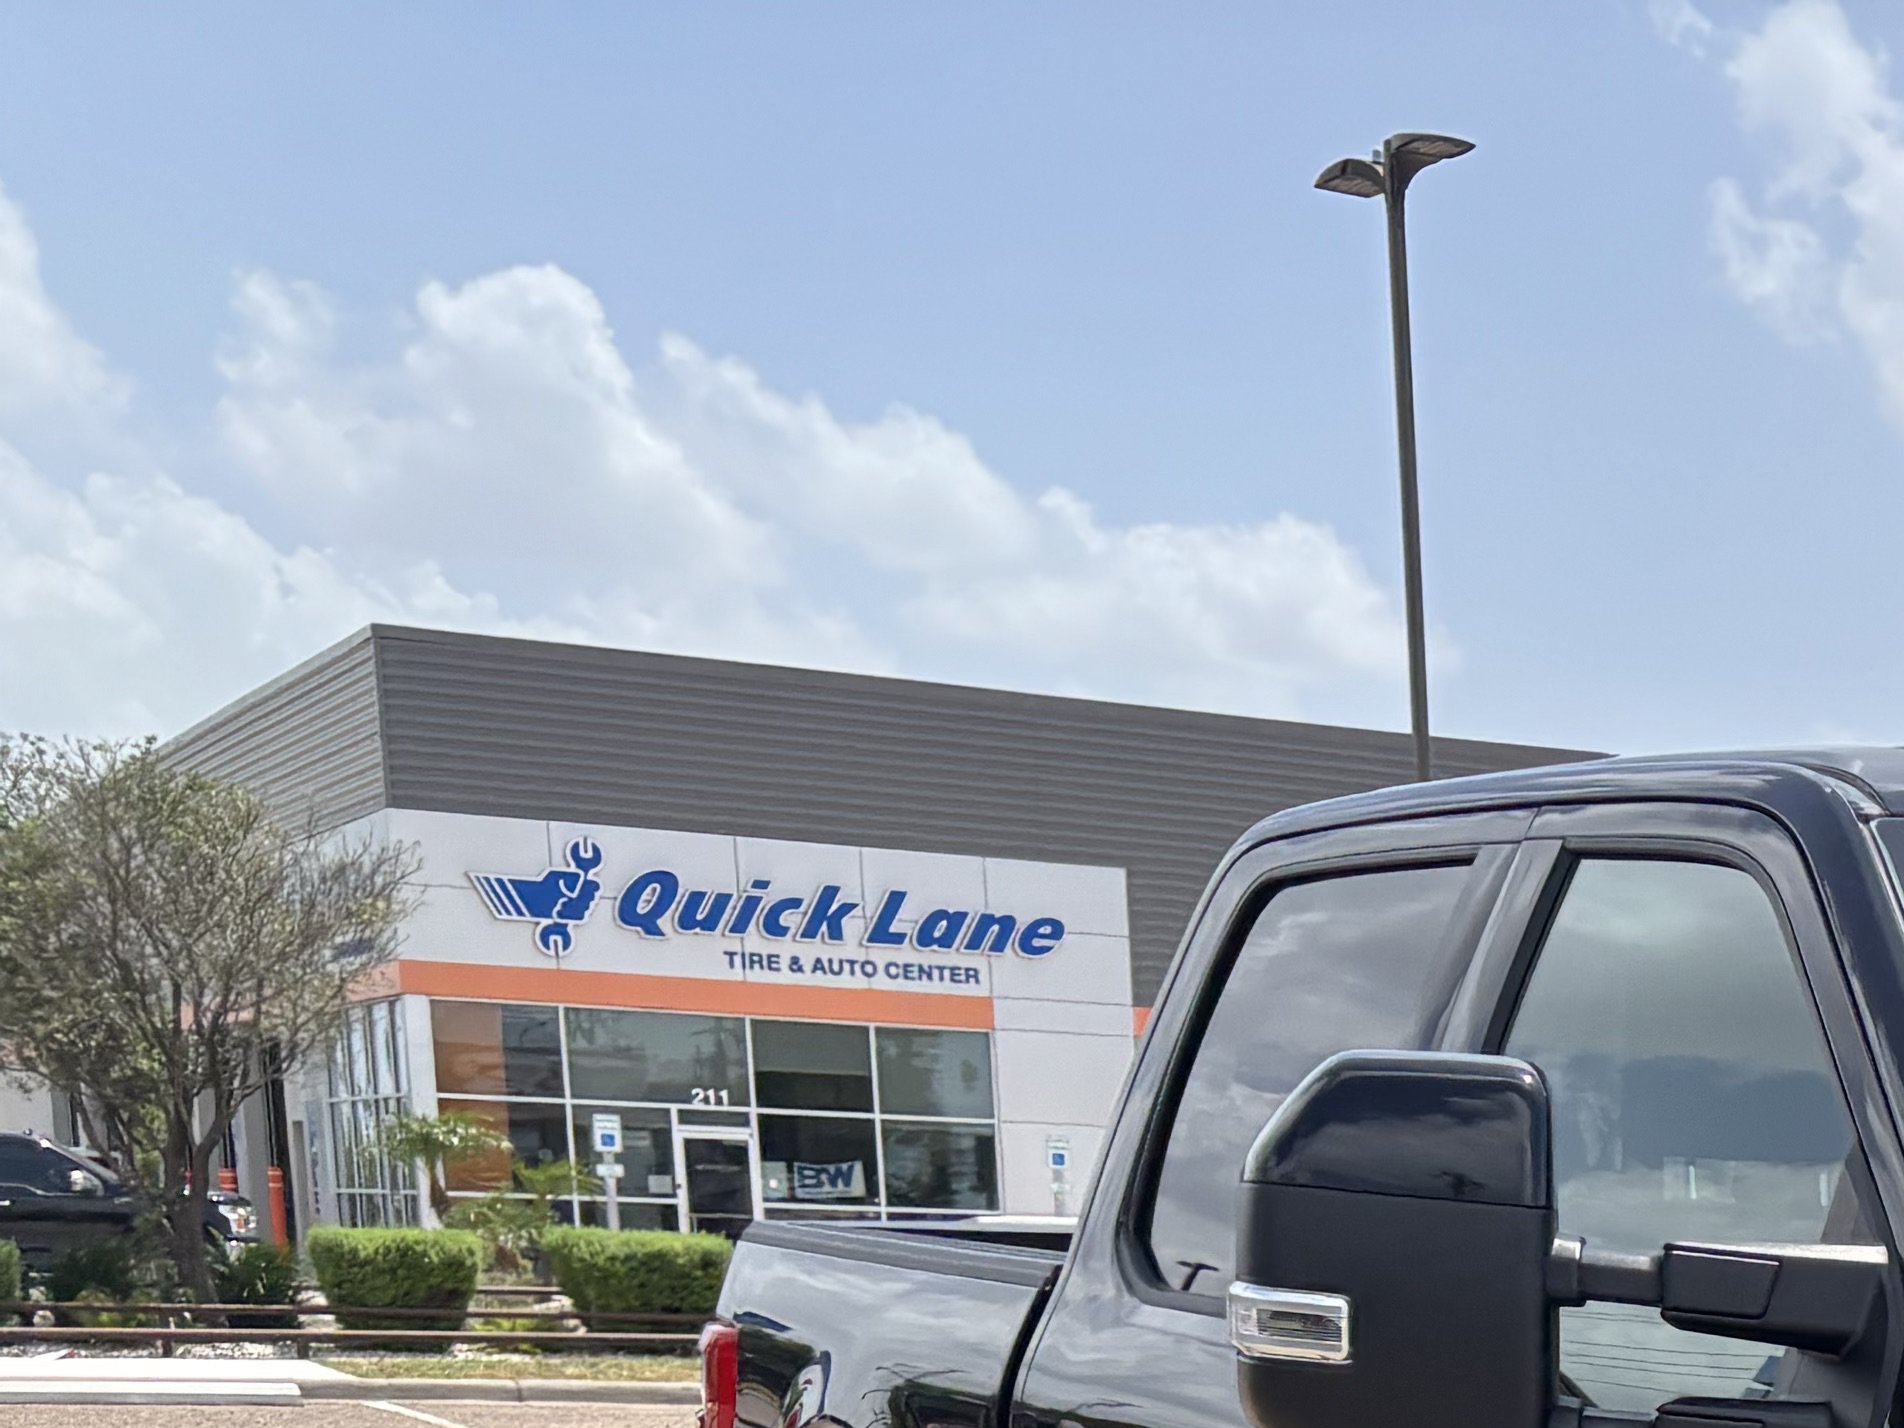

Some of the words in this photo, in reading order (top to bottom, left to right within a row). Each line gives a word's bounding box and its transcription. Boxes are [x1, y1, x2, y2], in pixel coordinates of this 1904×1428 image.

[616, 869, 861, 940] Quick
[865, 890, 1066, 955] Lane
[723, 951, 781, 972] TIRE
[788, 955, 804, 974] &
[811, 957, 877, 978] AUTO
[884, 961, 980, 985] CENTER
[691, 1087, 729, 1106] 211
